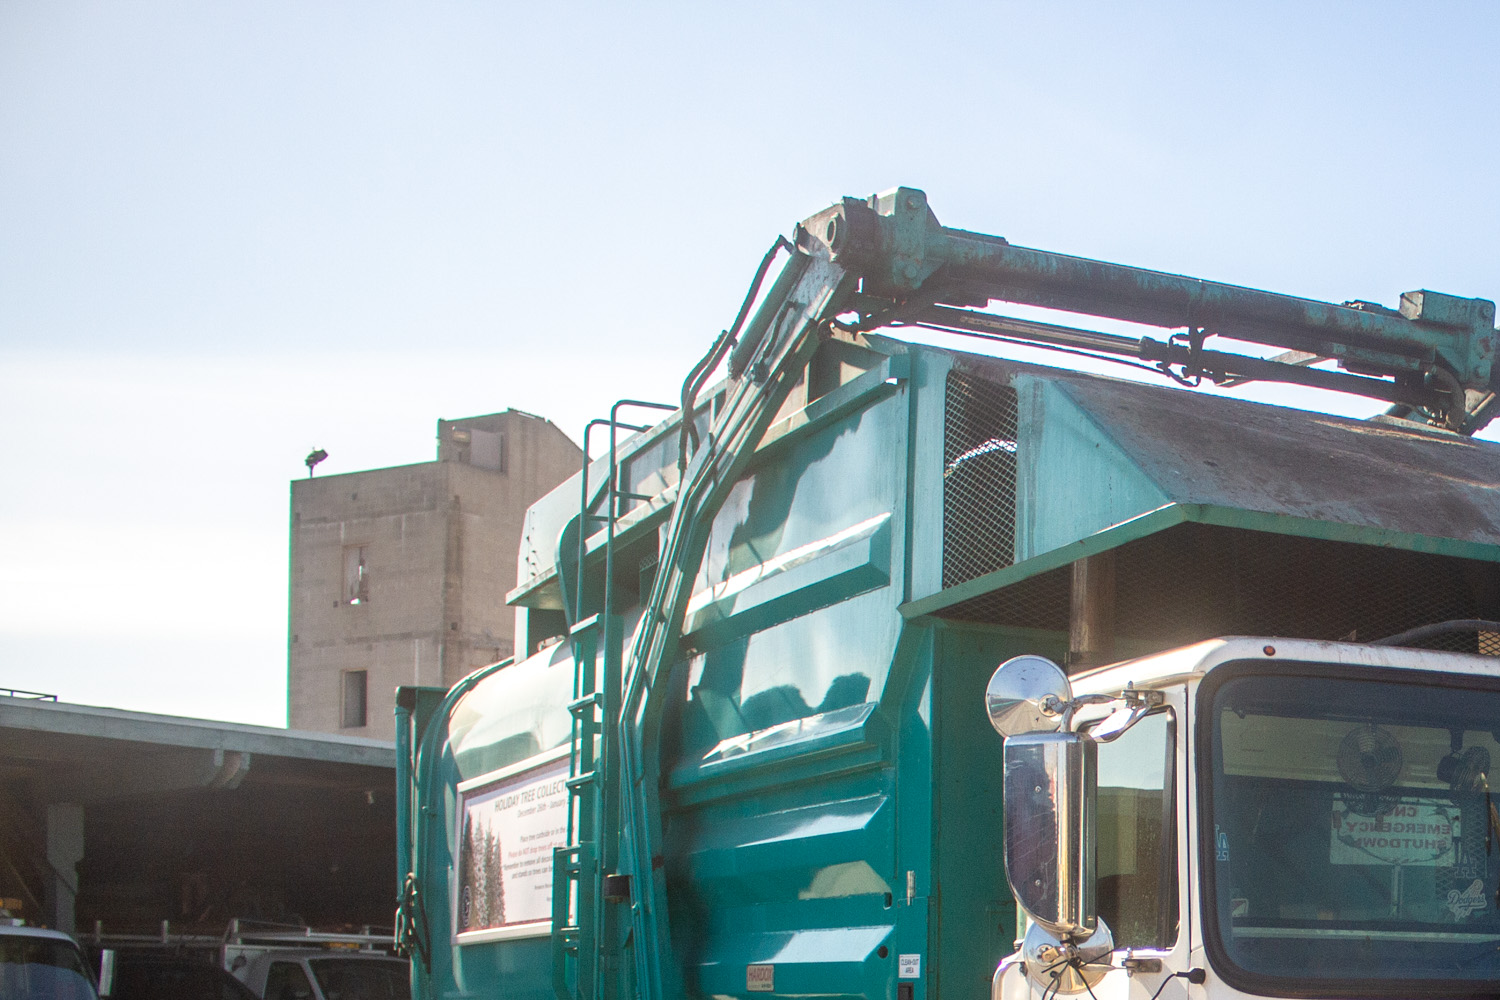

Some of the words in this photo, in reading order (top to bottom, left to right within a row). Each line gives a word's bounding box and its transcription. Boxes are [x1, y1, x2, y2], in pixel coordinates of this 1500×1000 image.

[494, 794, 520, 812] HOLIDAY
[521, 788, 535, 804] TREE
[537, 778, 567, 800] COLLECTI
